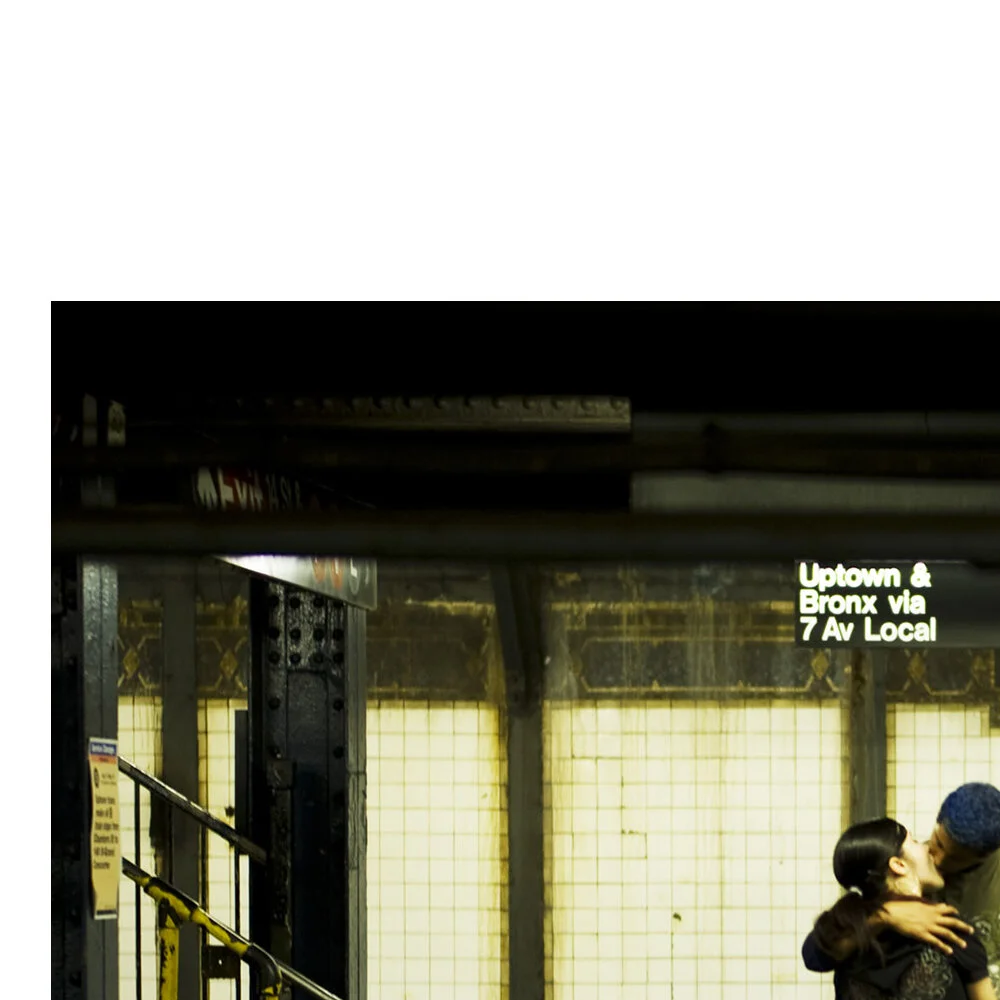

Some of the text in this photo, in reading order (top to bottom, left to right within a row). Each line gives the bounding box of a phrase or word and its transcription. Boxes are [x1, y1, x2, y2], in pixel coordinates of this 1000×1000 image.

[800, 562, 932, 592] Uptown &
[800, 589, 926, 615] Bronx via
[800, 617, 937, 642] 7 Av Local
